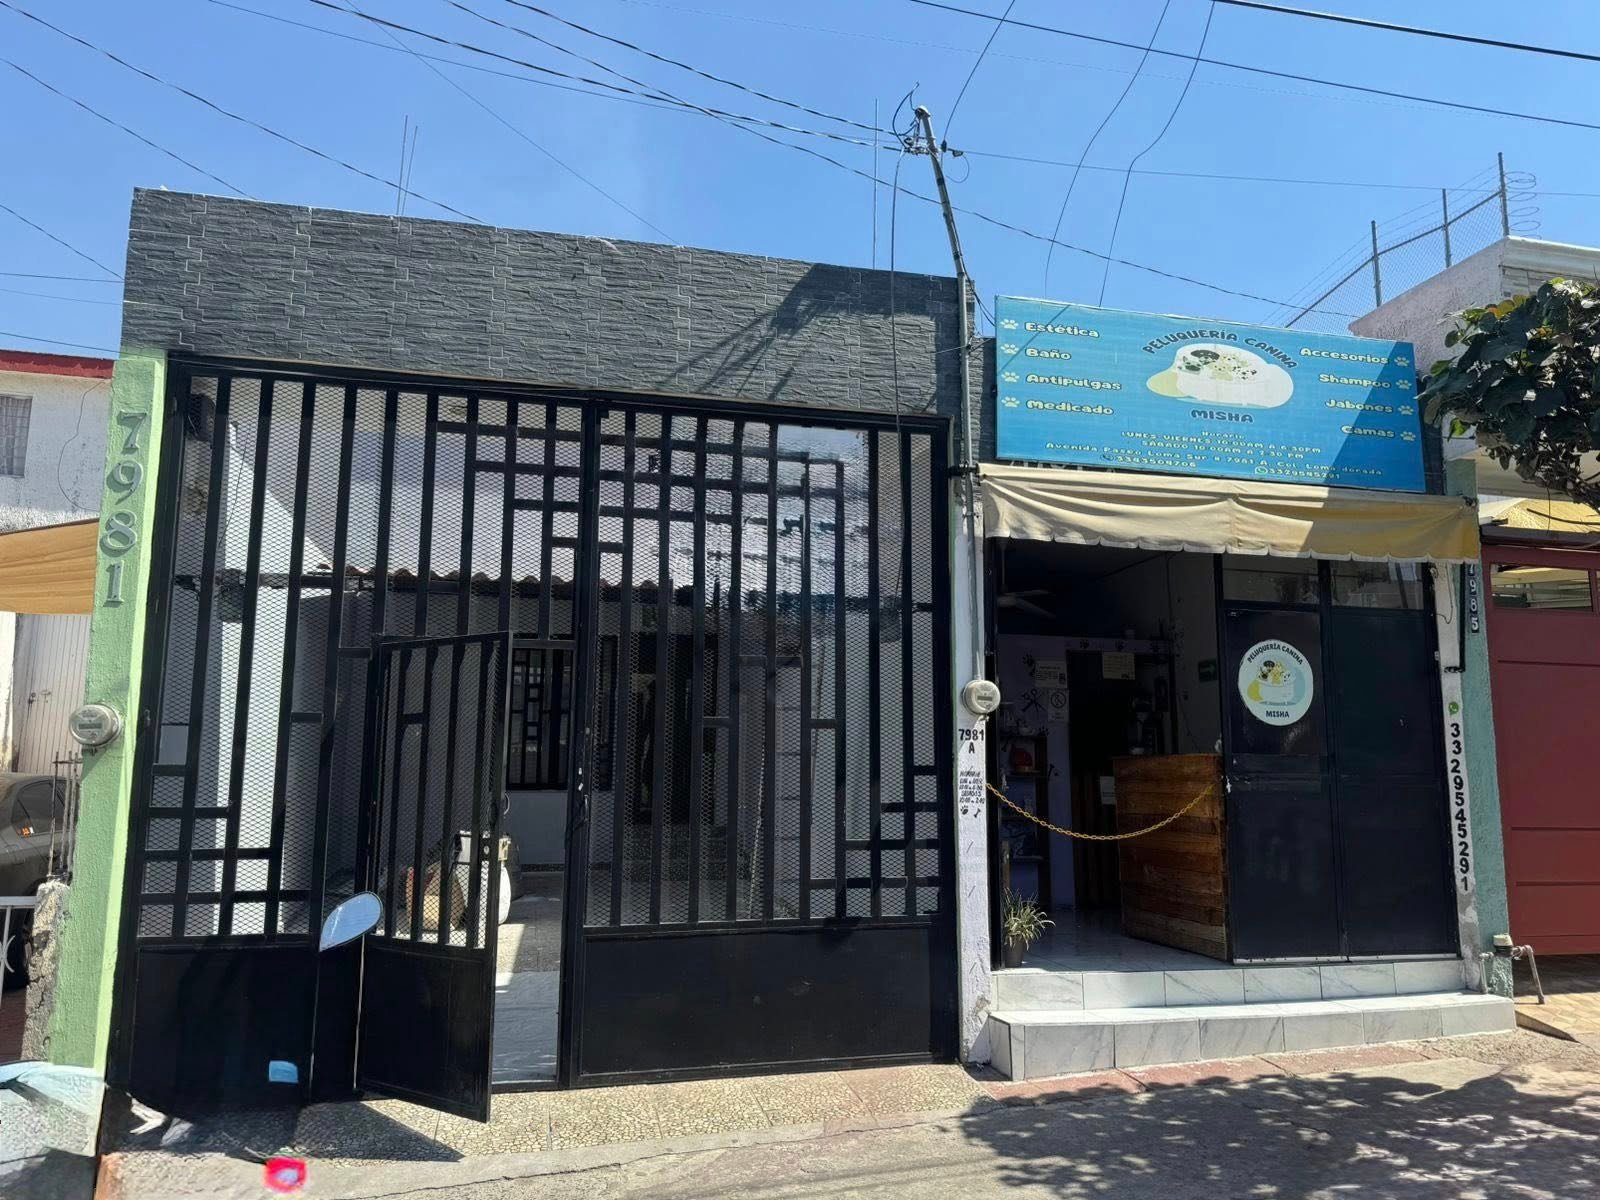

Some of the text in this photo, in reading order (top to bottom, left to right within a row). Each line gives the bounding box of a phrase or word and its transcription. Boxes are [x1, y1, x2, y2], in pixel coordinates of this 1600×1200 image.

[1024, 321, 1100, 338] Estética
[1025, 347, 1072, 361] Baño
[1142, 329, 1298, 369] PELUQUERÍA CANINA
[1300, 347, 1389, 364] Accesorios
[1025, 373, 1122, 391] Antipulgas
[1319, 373, 1392, 389] Shampoo
[1025, 399, 1114, 416] Medicado
[1325, 399, 1394, 414] Jabones
[1191, 409, 1254, 423] MISHA
[1341, 425, 1395, 439] Camas
[1046, 442, 1098, 452] Avenida
[1147, 450, 1181, 459] Loma
[1186, 453, 1208, 461] Sur
[104, 410, 147, 603] 7981
[1247, 643, 1303, 665] PELUQUERÍA CANINA
[1265, 710, 1290, 718] MISHA
[958, 729, 985, 741] 7981
[968, 742, 975, 754] A
[1450, 722, 1470, 891] 3329545291
